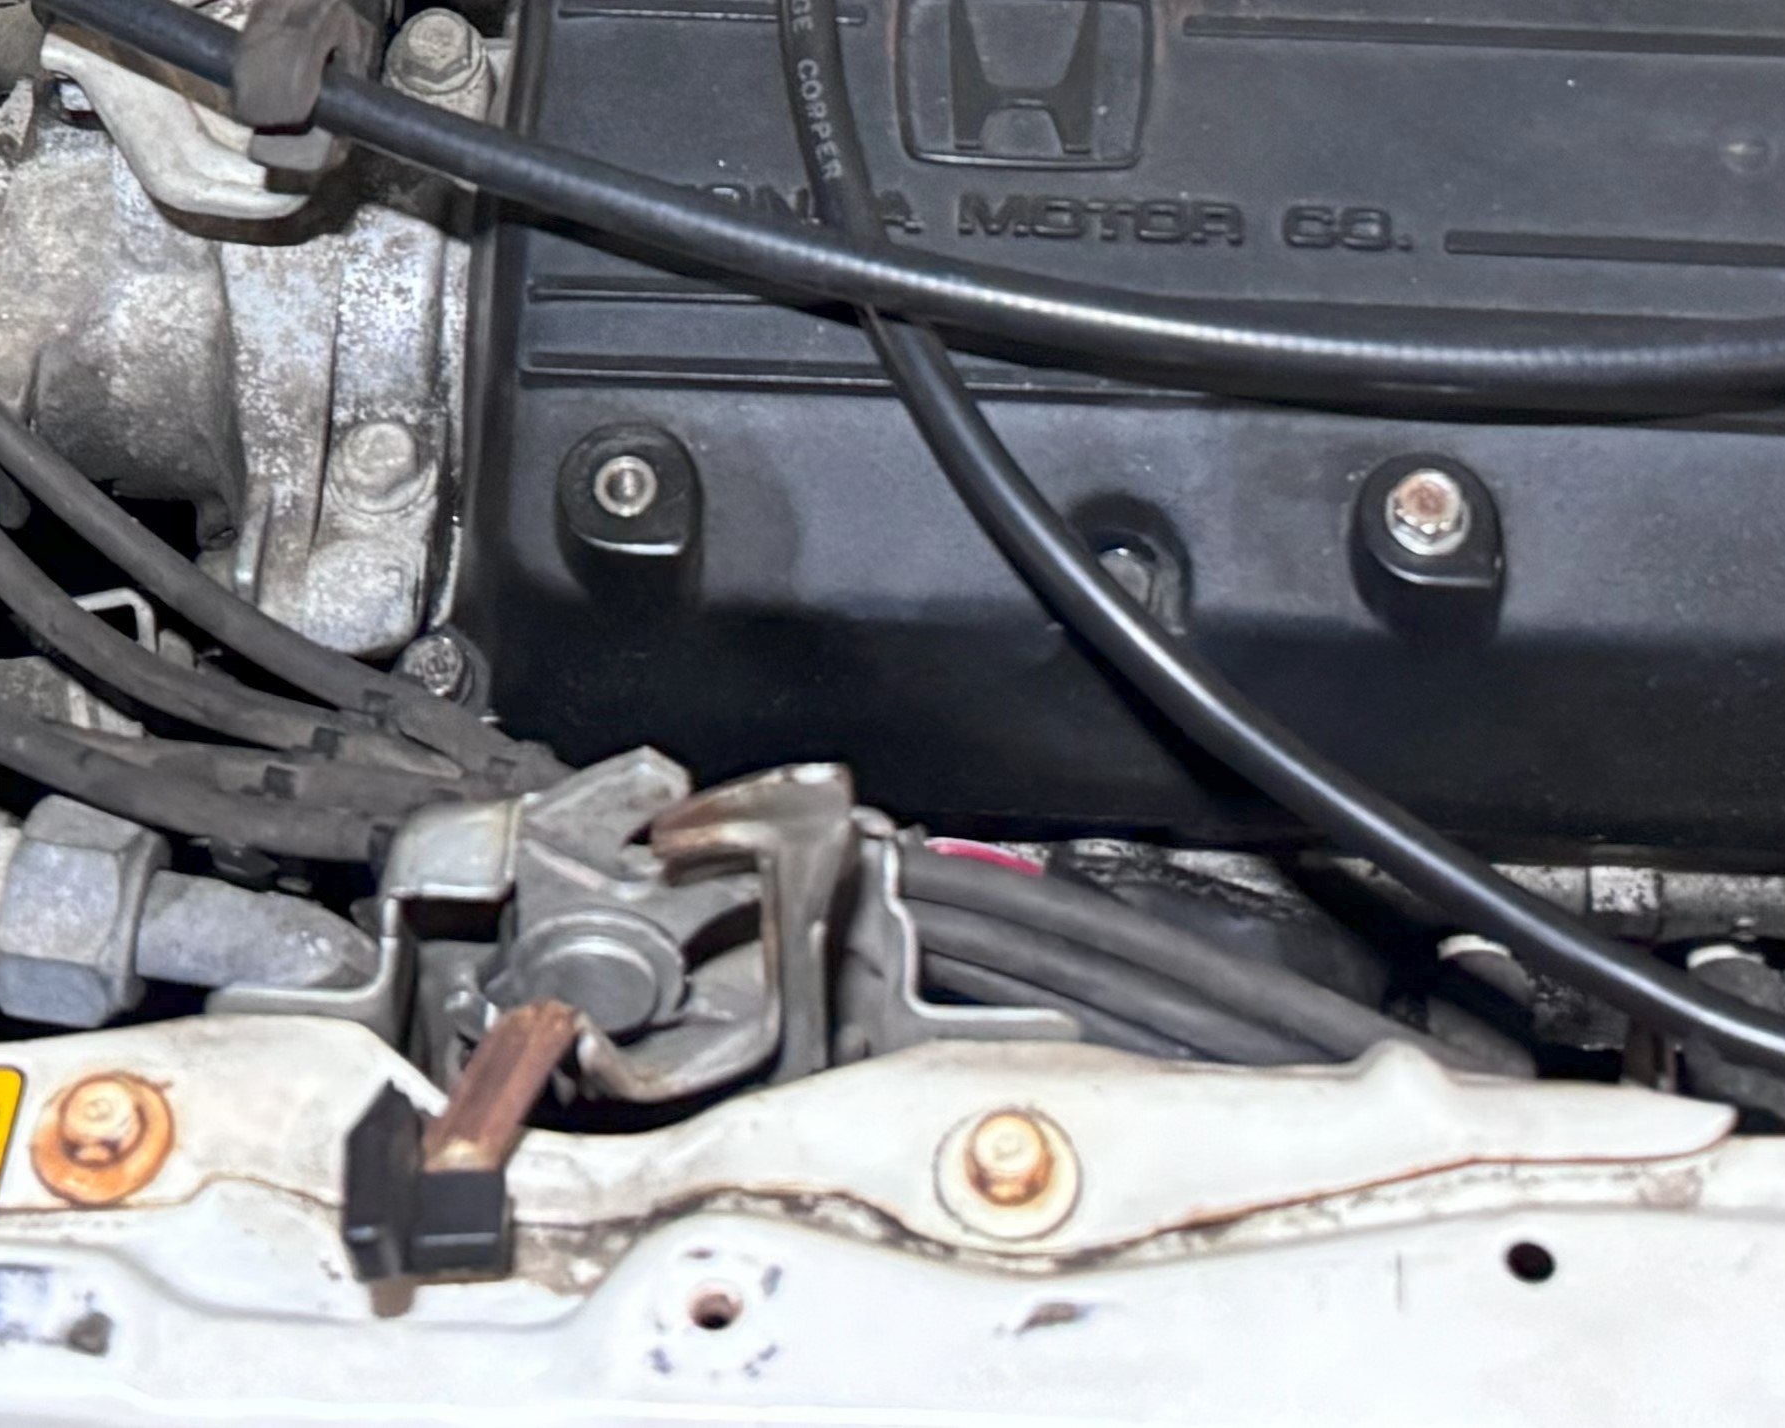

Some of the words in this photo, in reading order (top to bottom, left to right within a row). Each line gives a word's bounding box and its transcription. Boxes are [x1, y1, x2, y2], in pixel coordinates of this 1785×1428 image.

[797, 58, 844, 180] COPPER
[958, 191, 1245, 247] MOTOR
[1282, 204, 1414, 252] CO.
